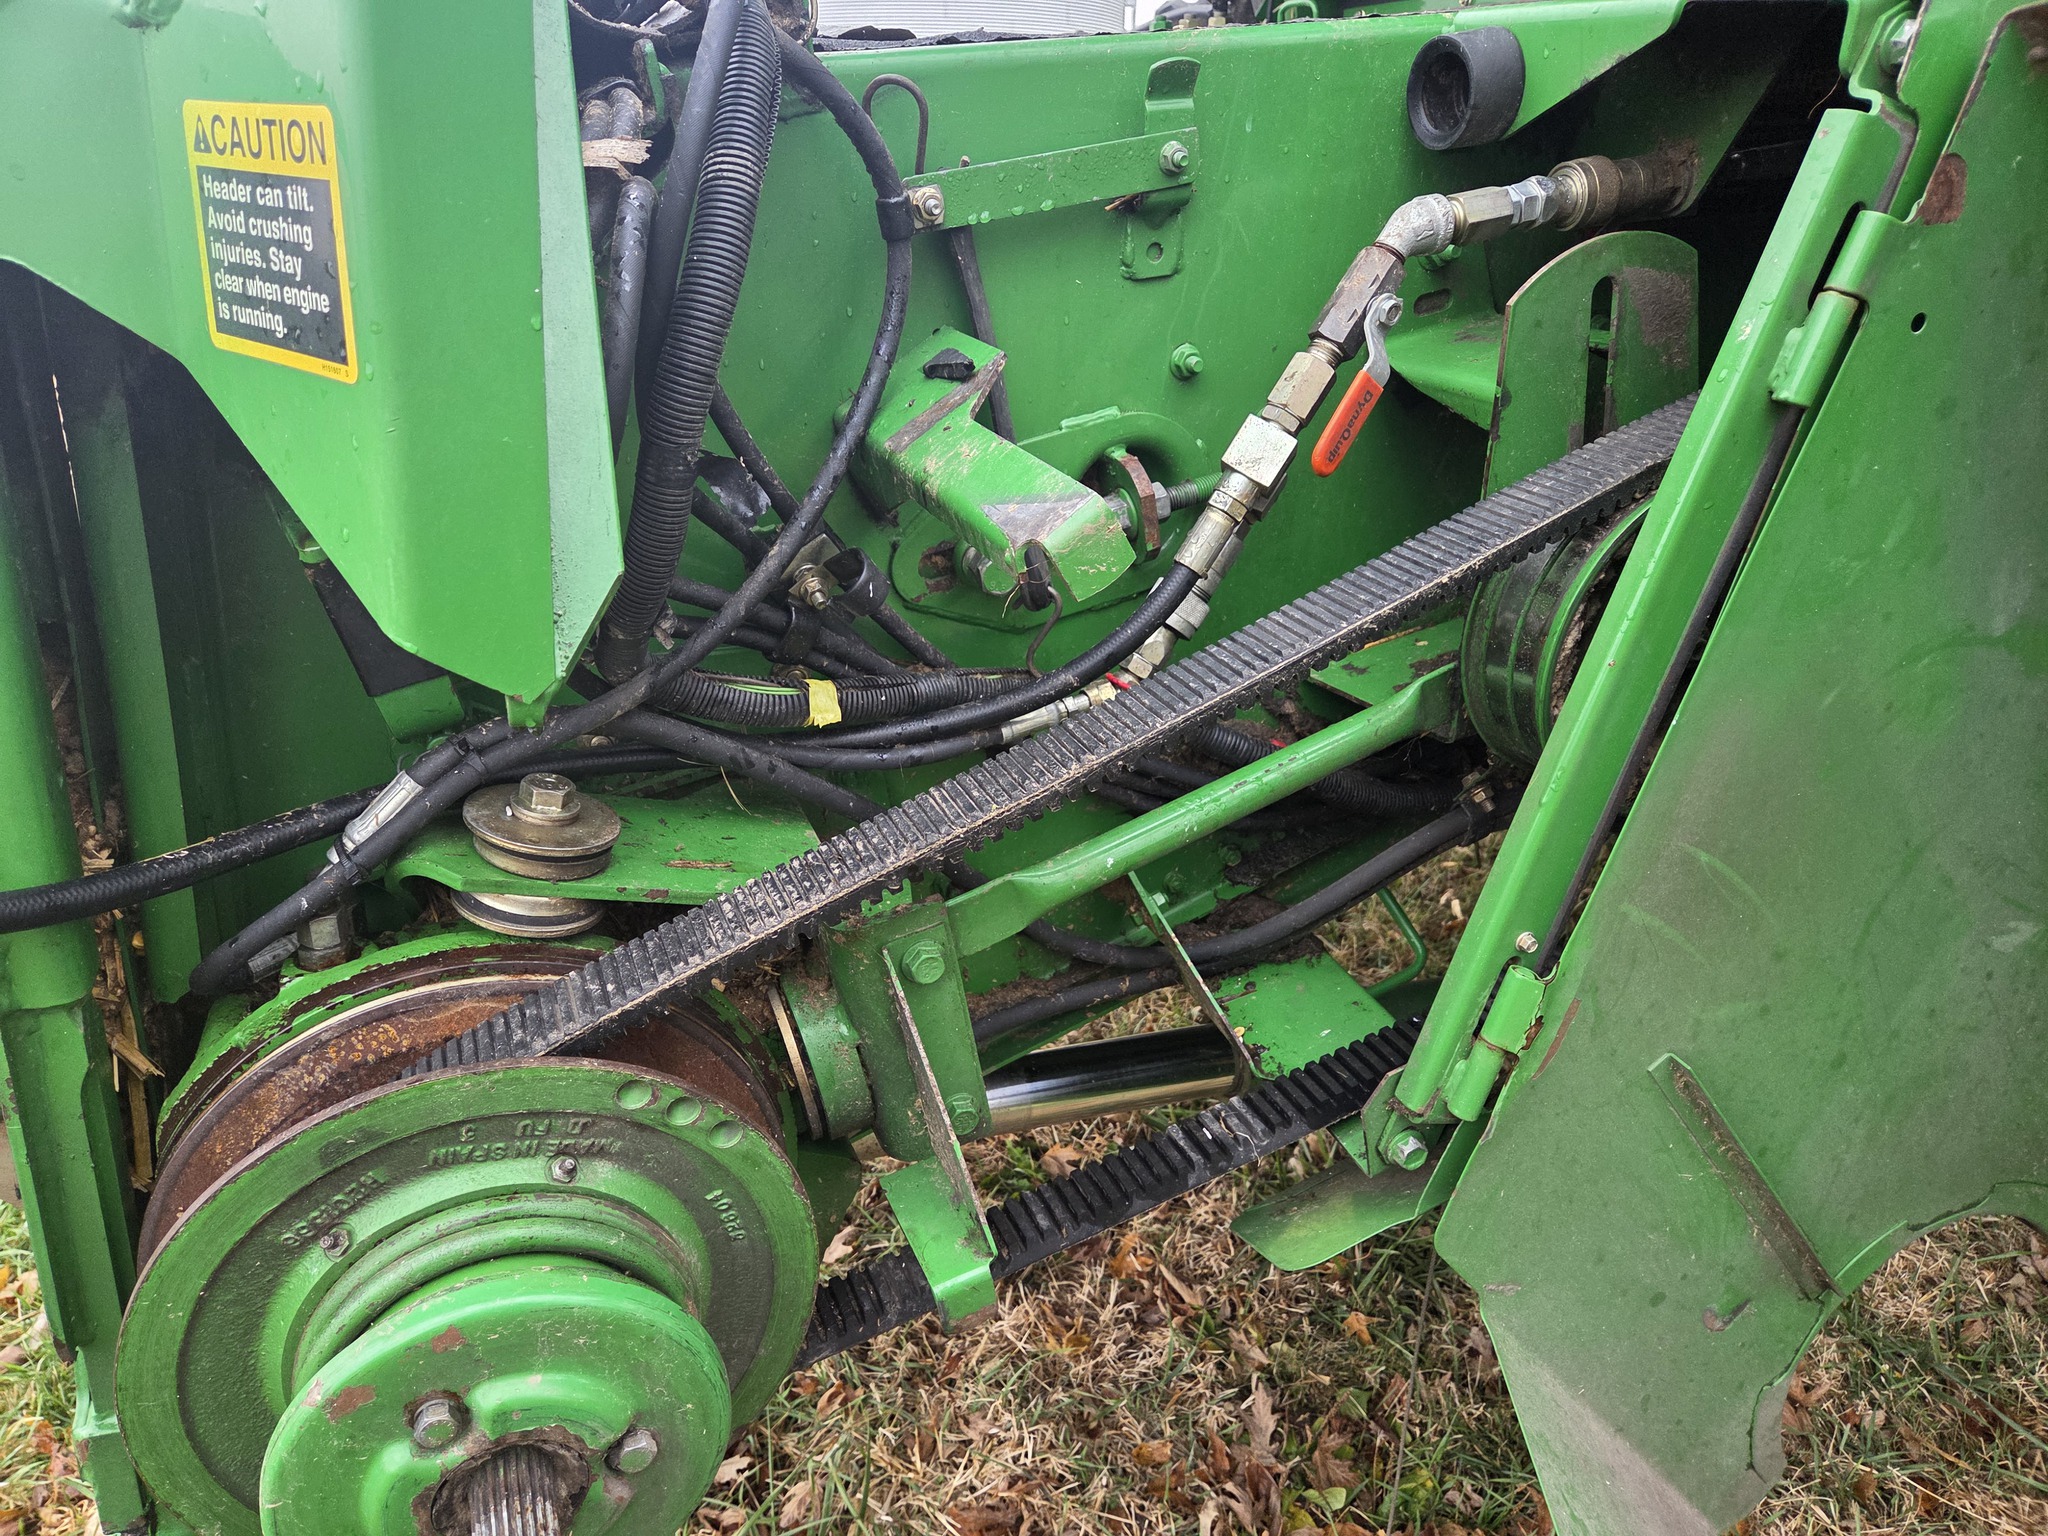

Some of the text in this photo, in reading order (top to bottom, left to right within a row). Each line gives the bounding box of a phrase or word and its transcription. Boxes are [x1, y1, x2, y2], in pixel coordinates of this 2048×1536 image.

[210, 114, 328, 166] CAUTION
[202, 173, 315, 213] Header can tilt.
[207, 205, 313, 252] Avoid crushing
[209, 236, 303, 282] injuries. Stay
[214, 267, 331, 314] clear when engine
[217, 296, 288, 339] is running.
[1327, 389, 1374, 464] DynaQuip
